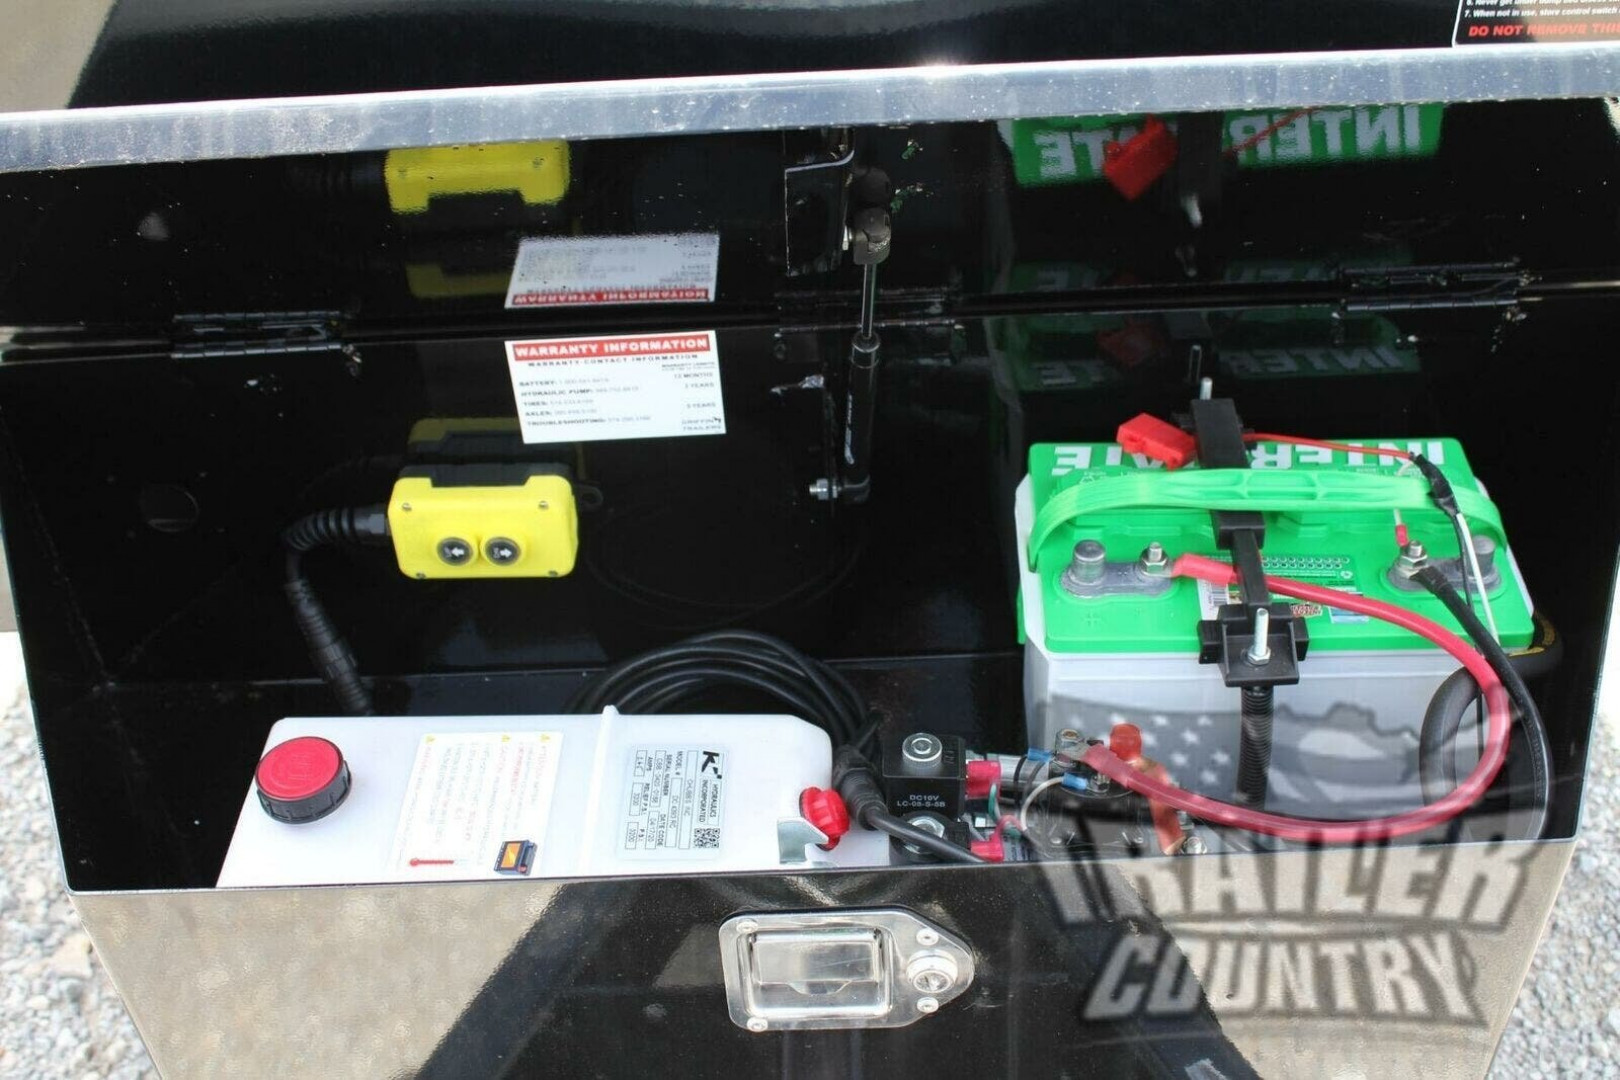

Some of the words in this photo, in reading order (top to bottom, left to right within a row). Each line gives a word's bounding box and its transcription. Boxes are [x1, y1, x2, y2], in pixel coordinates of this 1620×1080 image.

[1473, 9, 1496, 18] When
[1497, 9, 1511, 17] not
[1511, 9, 1521, 17] in
[1562, 7, 1592, 16] control
[1592, 7, 1618, 15] switch
[1469, 25, 1489, 37] DO
[1493, 25, 1523, 36] NOT
[1527, 23, 1587, 36] REMOVE
[515, 343, 598, 357] WARRANTY
[603, 338, 707, 353] INFORMATION
[528, 359, 580, 367] WARRANTY
[584, 357, 628, 365] CONTACT
[631, 354, 698, 362] INFORMATION
[699, 779, 709, 824] INCORPORATED
[709, 783, 719, 819] HYDRAULICS
[658, 813, 667, 829] DATE
[656, 829, 665, 847] CODE
